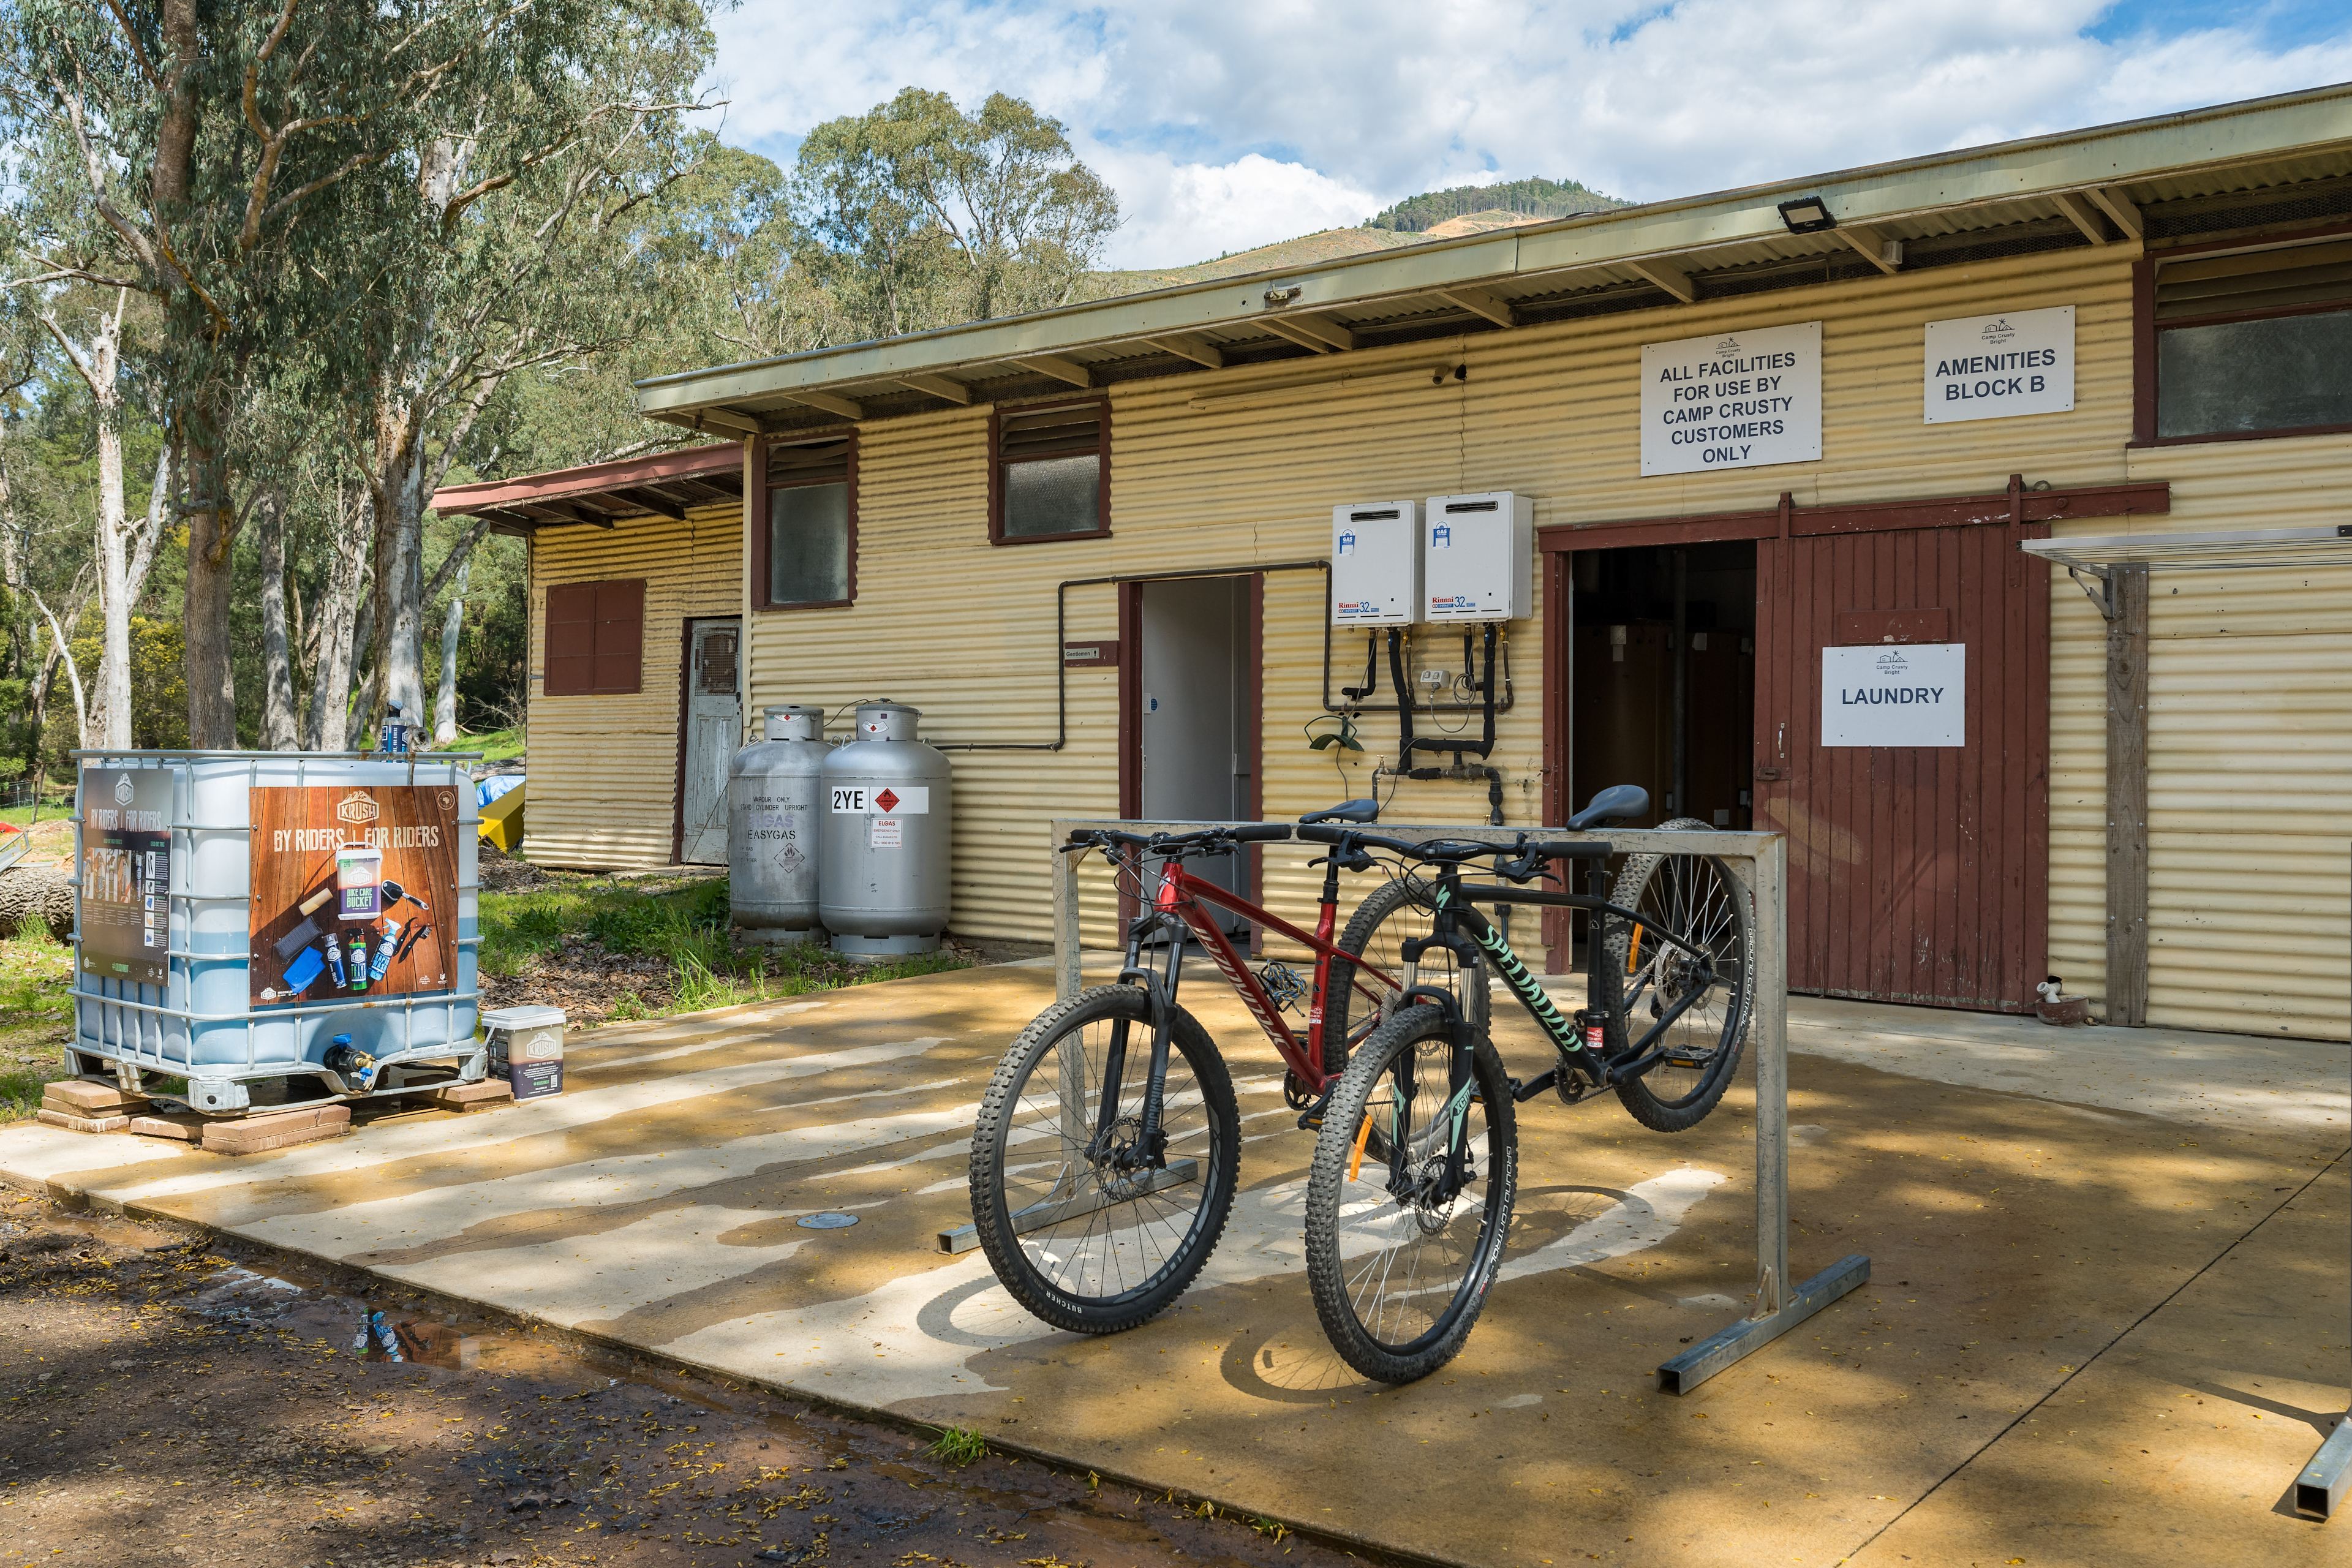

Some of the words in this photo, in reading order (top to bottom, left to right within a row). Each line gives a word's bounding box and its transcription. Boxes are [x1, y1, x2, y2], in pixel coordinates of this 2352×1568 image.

[1660, 366, 1693, 383] ALL
[1699, 352, 1796, 378] FACILITIES
[1936, 349, 2056, 377] AMENITIES
[1674, 384, 1709, 402] FOR
[1715, 379, 1751, 397] USE
[1757, 375, 1782, 393] BY
[1946, 377, 2023, 401] BLOCK
[2030, 375, 2045, 393] B
[1663, 405, 1714, 424] CAMP
[1719, 396, 1793, 418] CRUSTY
[1672, 420, 1784, 445] CUSTOMERS
[1703, 445, 1752, 463] ONLY
[1359, 601, 1370, 612] 32
[1454, 596, 1465, 607] 32
[1842, 687, 1945, 704] LAUNDRY
[117, 784, 132, 802] KRUSH
[834, 791, 864, 809] 2YE
[91, 809, 98, 829] BY
[99, 809, 118, 831] RIDERS
[126, 810, 137, 832] FOR
[138, 810, 161, 832] RIDERS
[341, 804, 375, 821] KRUSH
[274, 829, 291, 852] BY
[295, 827, 345, 851] RIDERS
[364, 827, 389, 850] FOR
[393, 825, 439, 848] RIDERS
[747, 829, 796, 840] EASYGAS
[347, 888, 358, 897] BIKE
[359, 888, 372, 896] CARE
[347, 896, 372, 908] BUCKET
[1194, 927, 1292, 1049] SPECIALIZED
[1473, 924, 1583, 1052] SPECIALIZED
[1741, 977, 1753, 1027] CONTROL
[529, 1041, 554, 1057] KRUSH
[1146, 1076, 1166, 1134] ROCKSHOX
[1504, 1145, 1512, 1202] GROUND
[1490, 1204, 1509, 1264] CONTROL
[1046, 1290, 1082, 1314] BUTCHER
